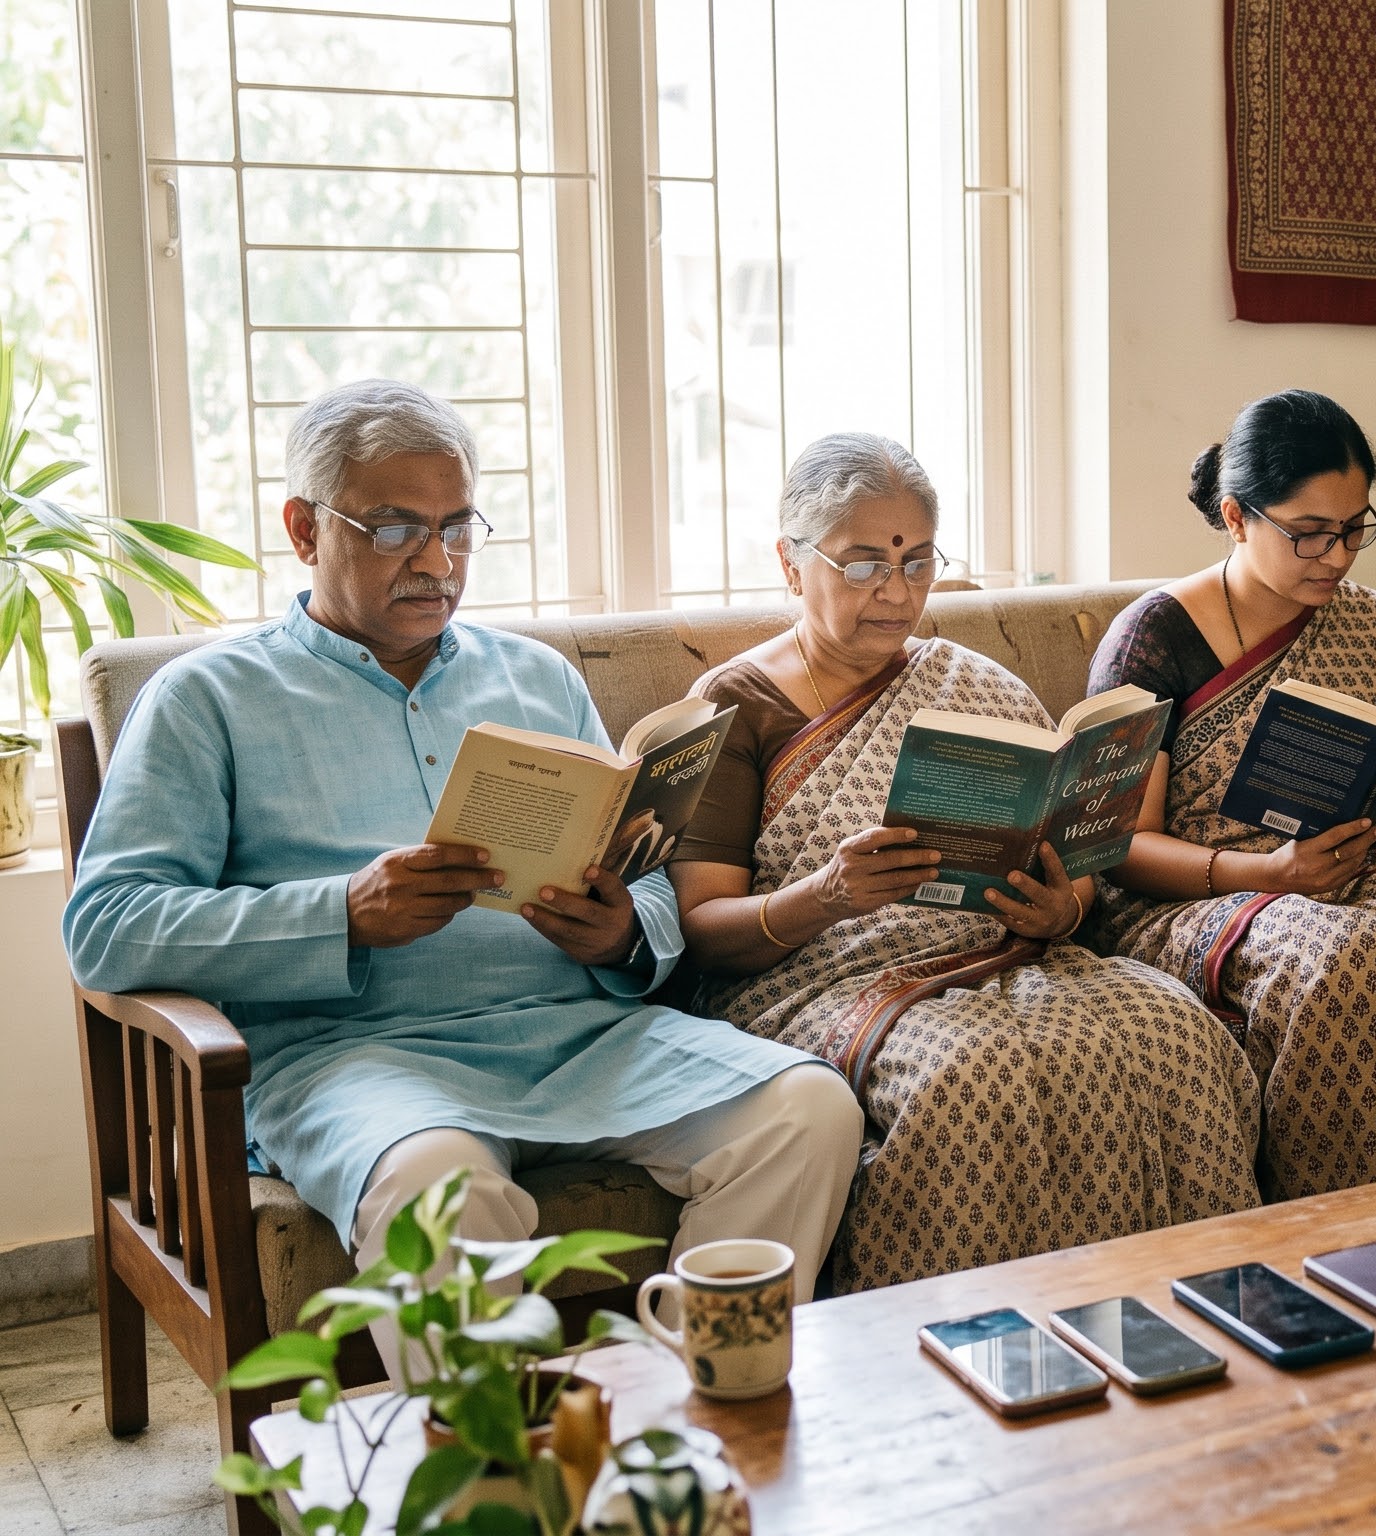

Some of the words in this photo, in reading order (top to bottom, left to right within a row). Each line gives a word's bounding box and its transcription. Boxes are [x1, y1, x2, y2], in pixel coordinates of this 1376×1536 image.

[1095, 743, 1128, 764] The
[1062, 758, 1148, 798] Covenant
[1085, 789, 1110, 814] of
[1064, 815, 1118, 841] Water
